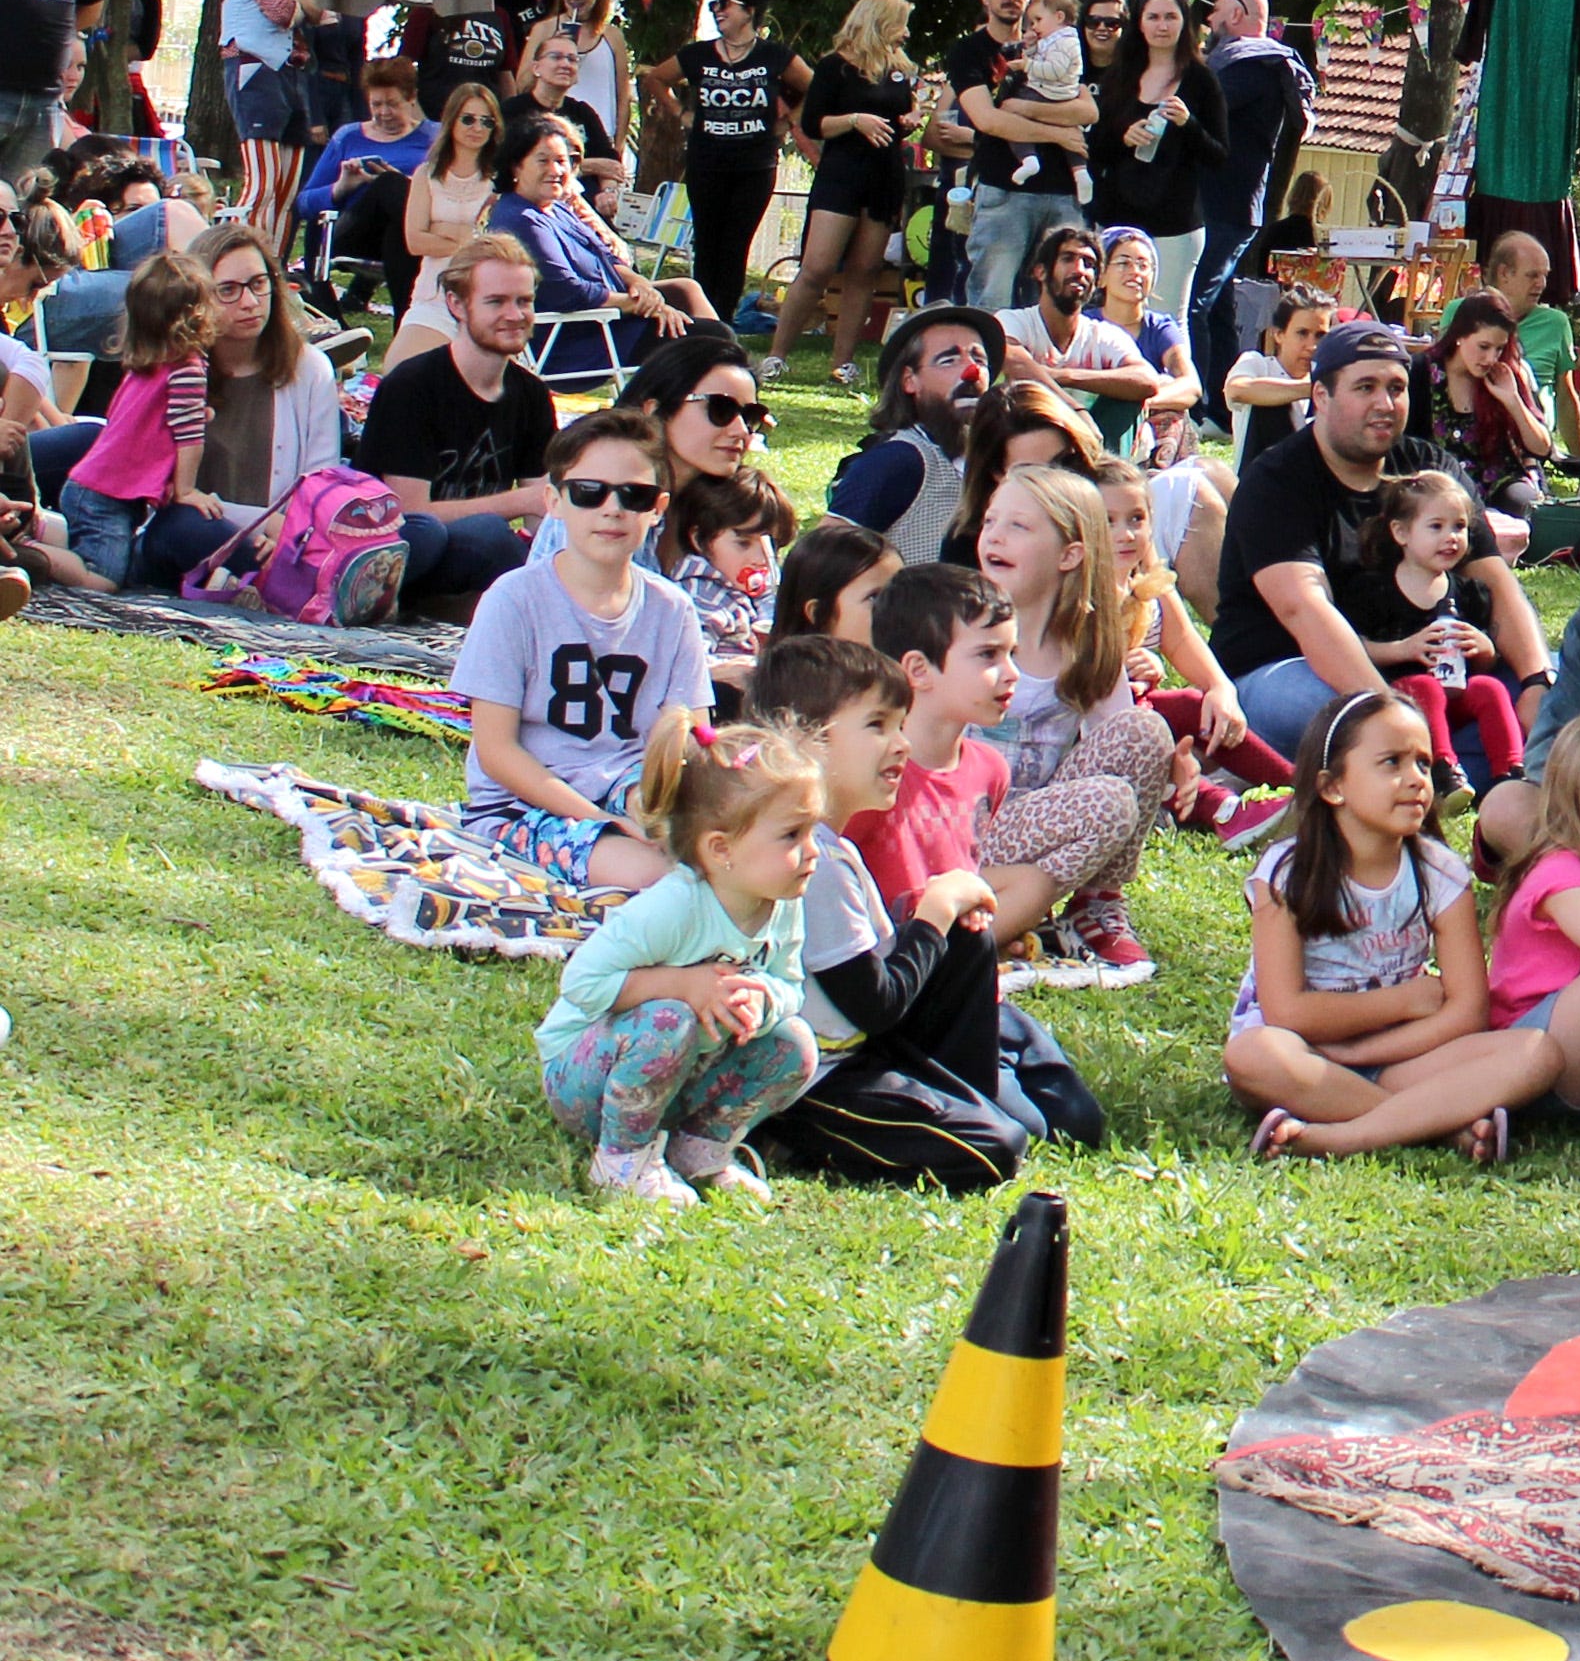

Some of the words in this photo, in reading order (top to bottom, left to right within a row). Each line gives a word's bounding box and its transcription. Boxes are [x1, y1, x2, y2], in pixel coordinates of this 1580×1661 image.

[517, 7, 536, 22] TE
[702, 66, 719, 77] TE
[699, 87, 769, 108] BOCA
[547, 643, 648, 741] 89
